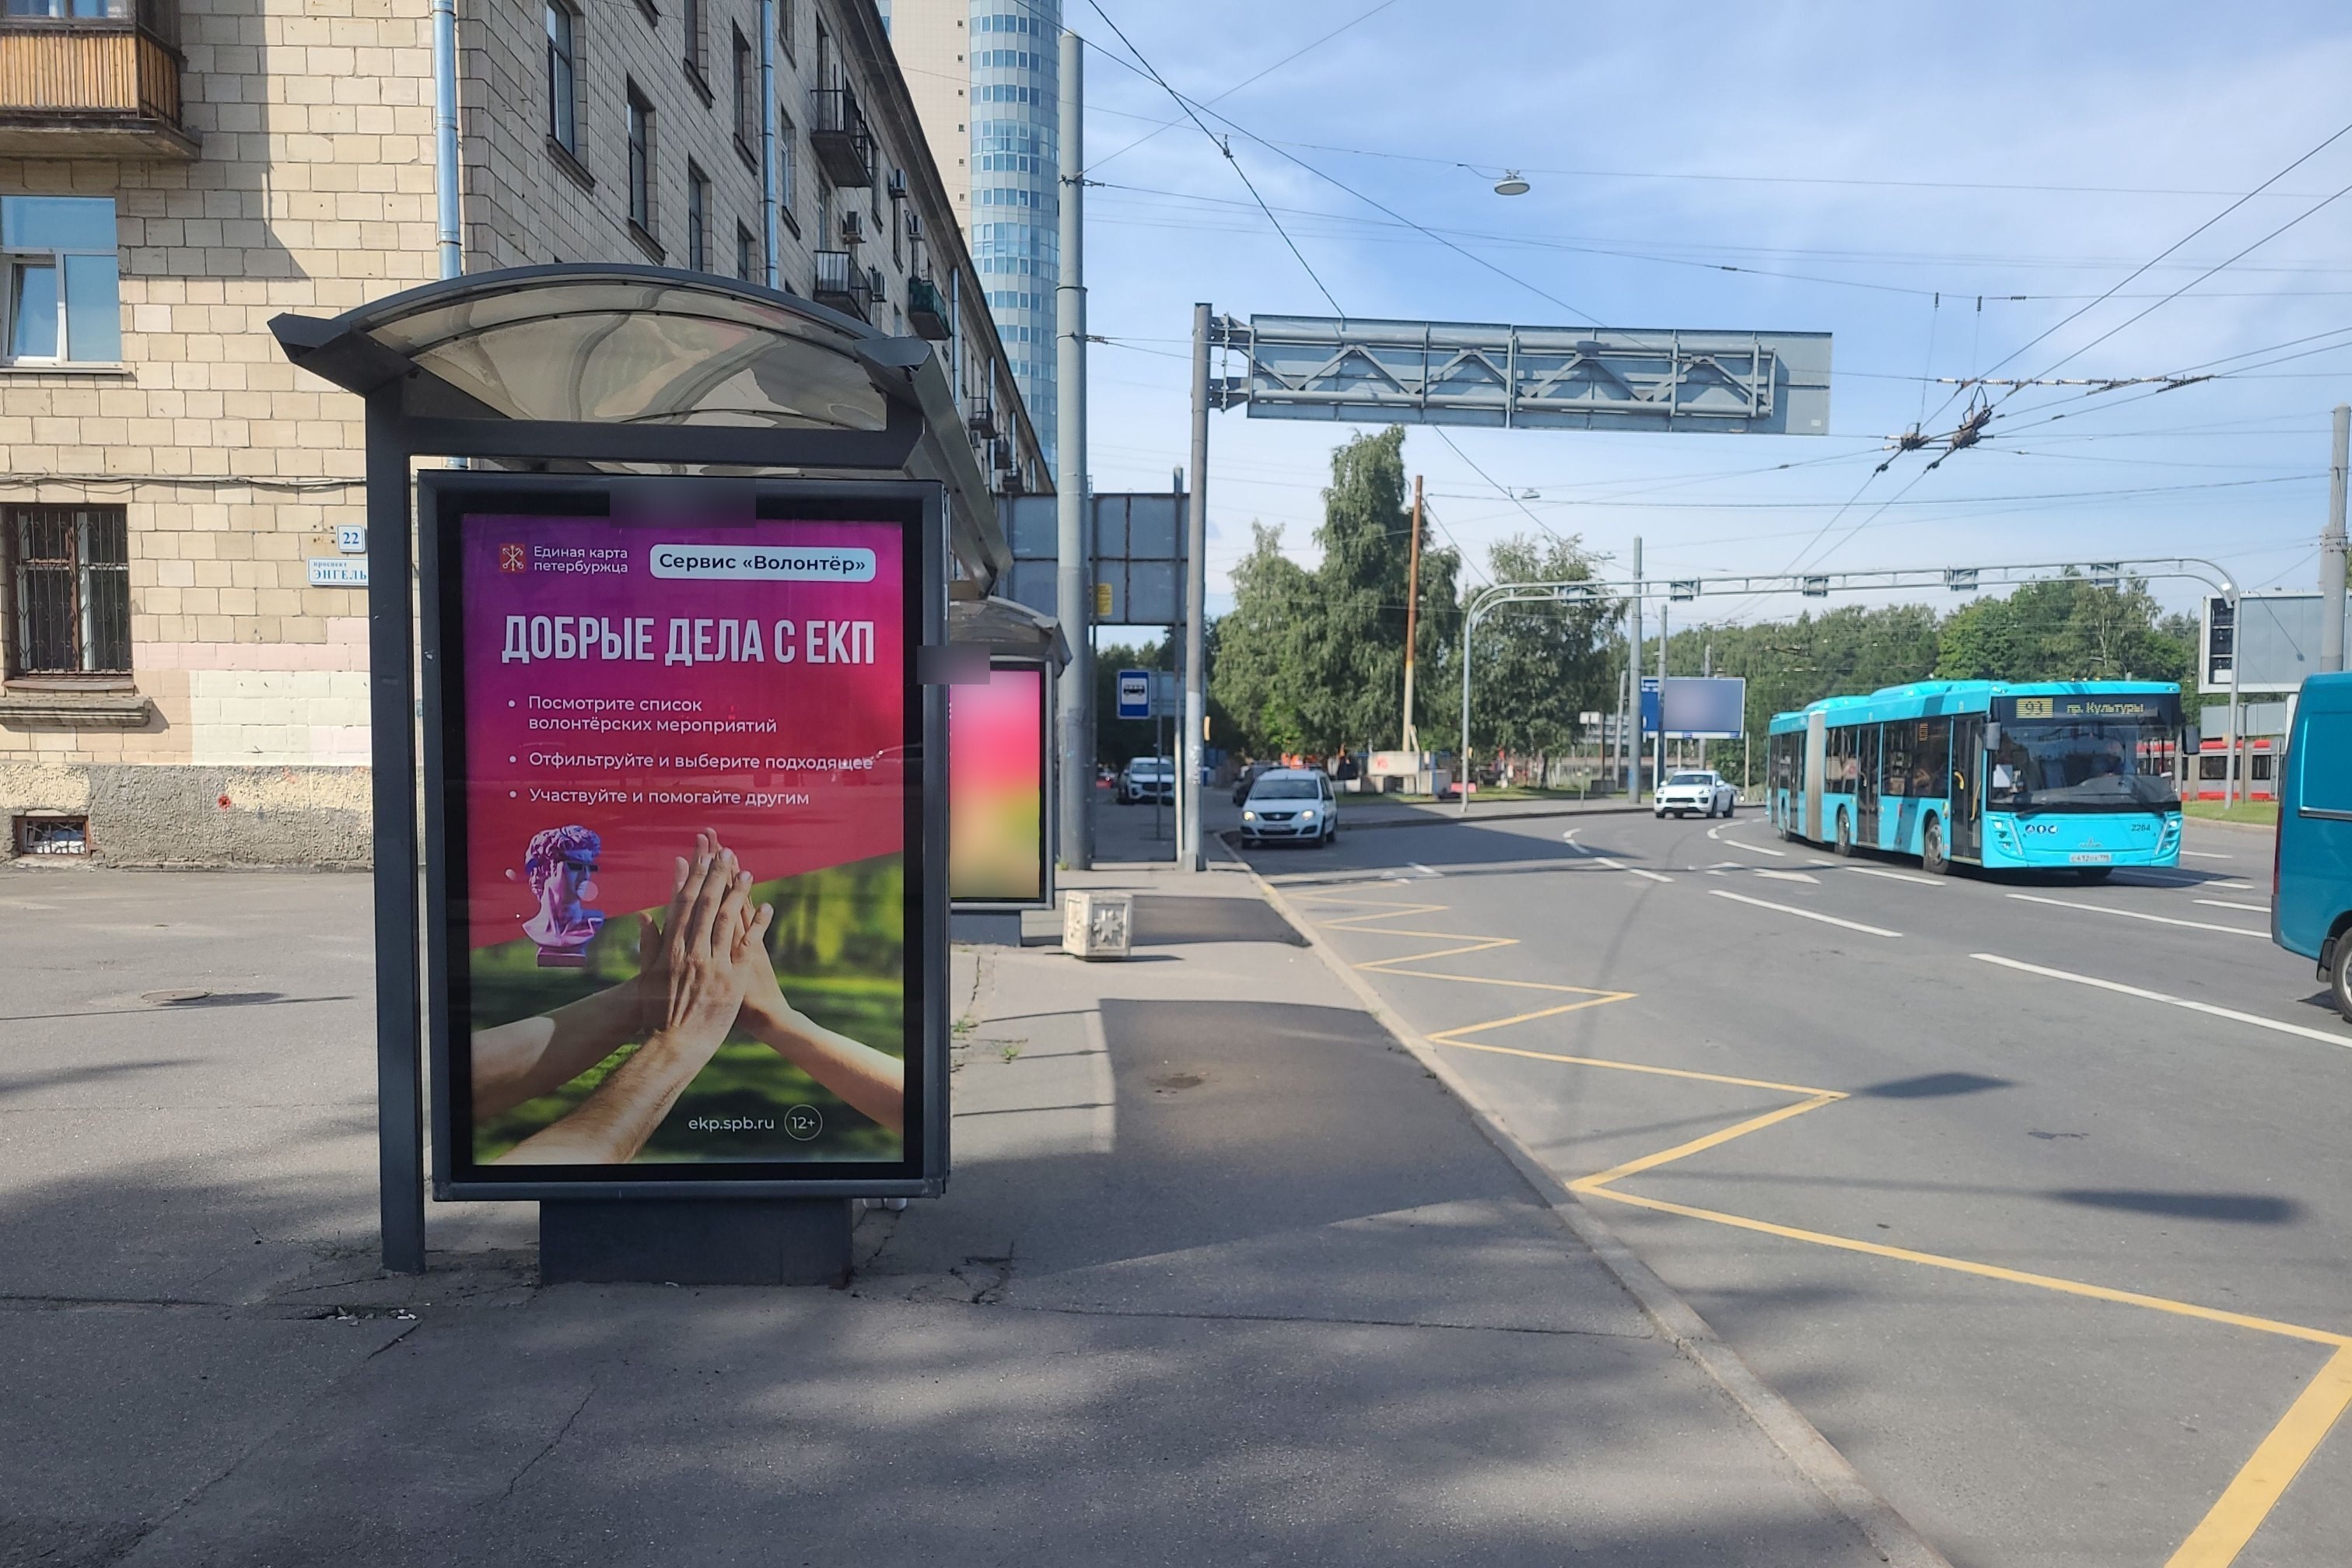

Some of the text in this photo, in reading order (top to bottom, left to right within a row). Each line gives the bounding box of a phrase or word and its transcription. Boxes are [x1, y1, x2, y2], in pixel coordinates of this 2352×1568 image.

[342, 532, 360, 544] 22
[534, 546, 628, 561] Единая карта
[534, 561, 628, 574] петербуржца
[659, 553, 866, 573] Сервис «Волонтёр»
[313, 570, 367, 580] ЭНГЕЛЬ
[502, 616, 875, 667] ДОБРЫЕ ДЕЛА С ЕКП
[529, 696, 702, 715] Посмотрите список
[2025, 702, 2043, 716] 93
[2067, 702, 2144, 715] пр. Культуры
[529, 716, 777, 733] волонтёрских мероприятий
[529, 751, 873, 771] Отфильтруйте и выберите подходящее
[530, 788, 810, 807] Участвуйте и помогайте другим
[688, 1116, 775, 1132] ekp.spb.ru
[791, 1117, 815, 1129] 12+
